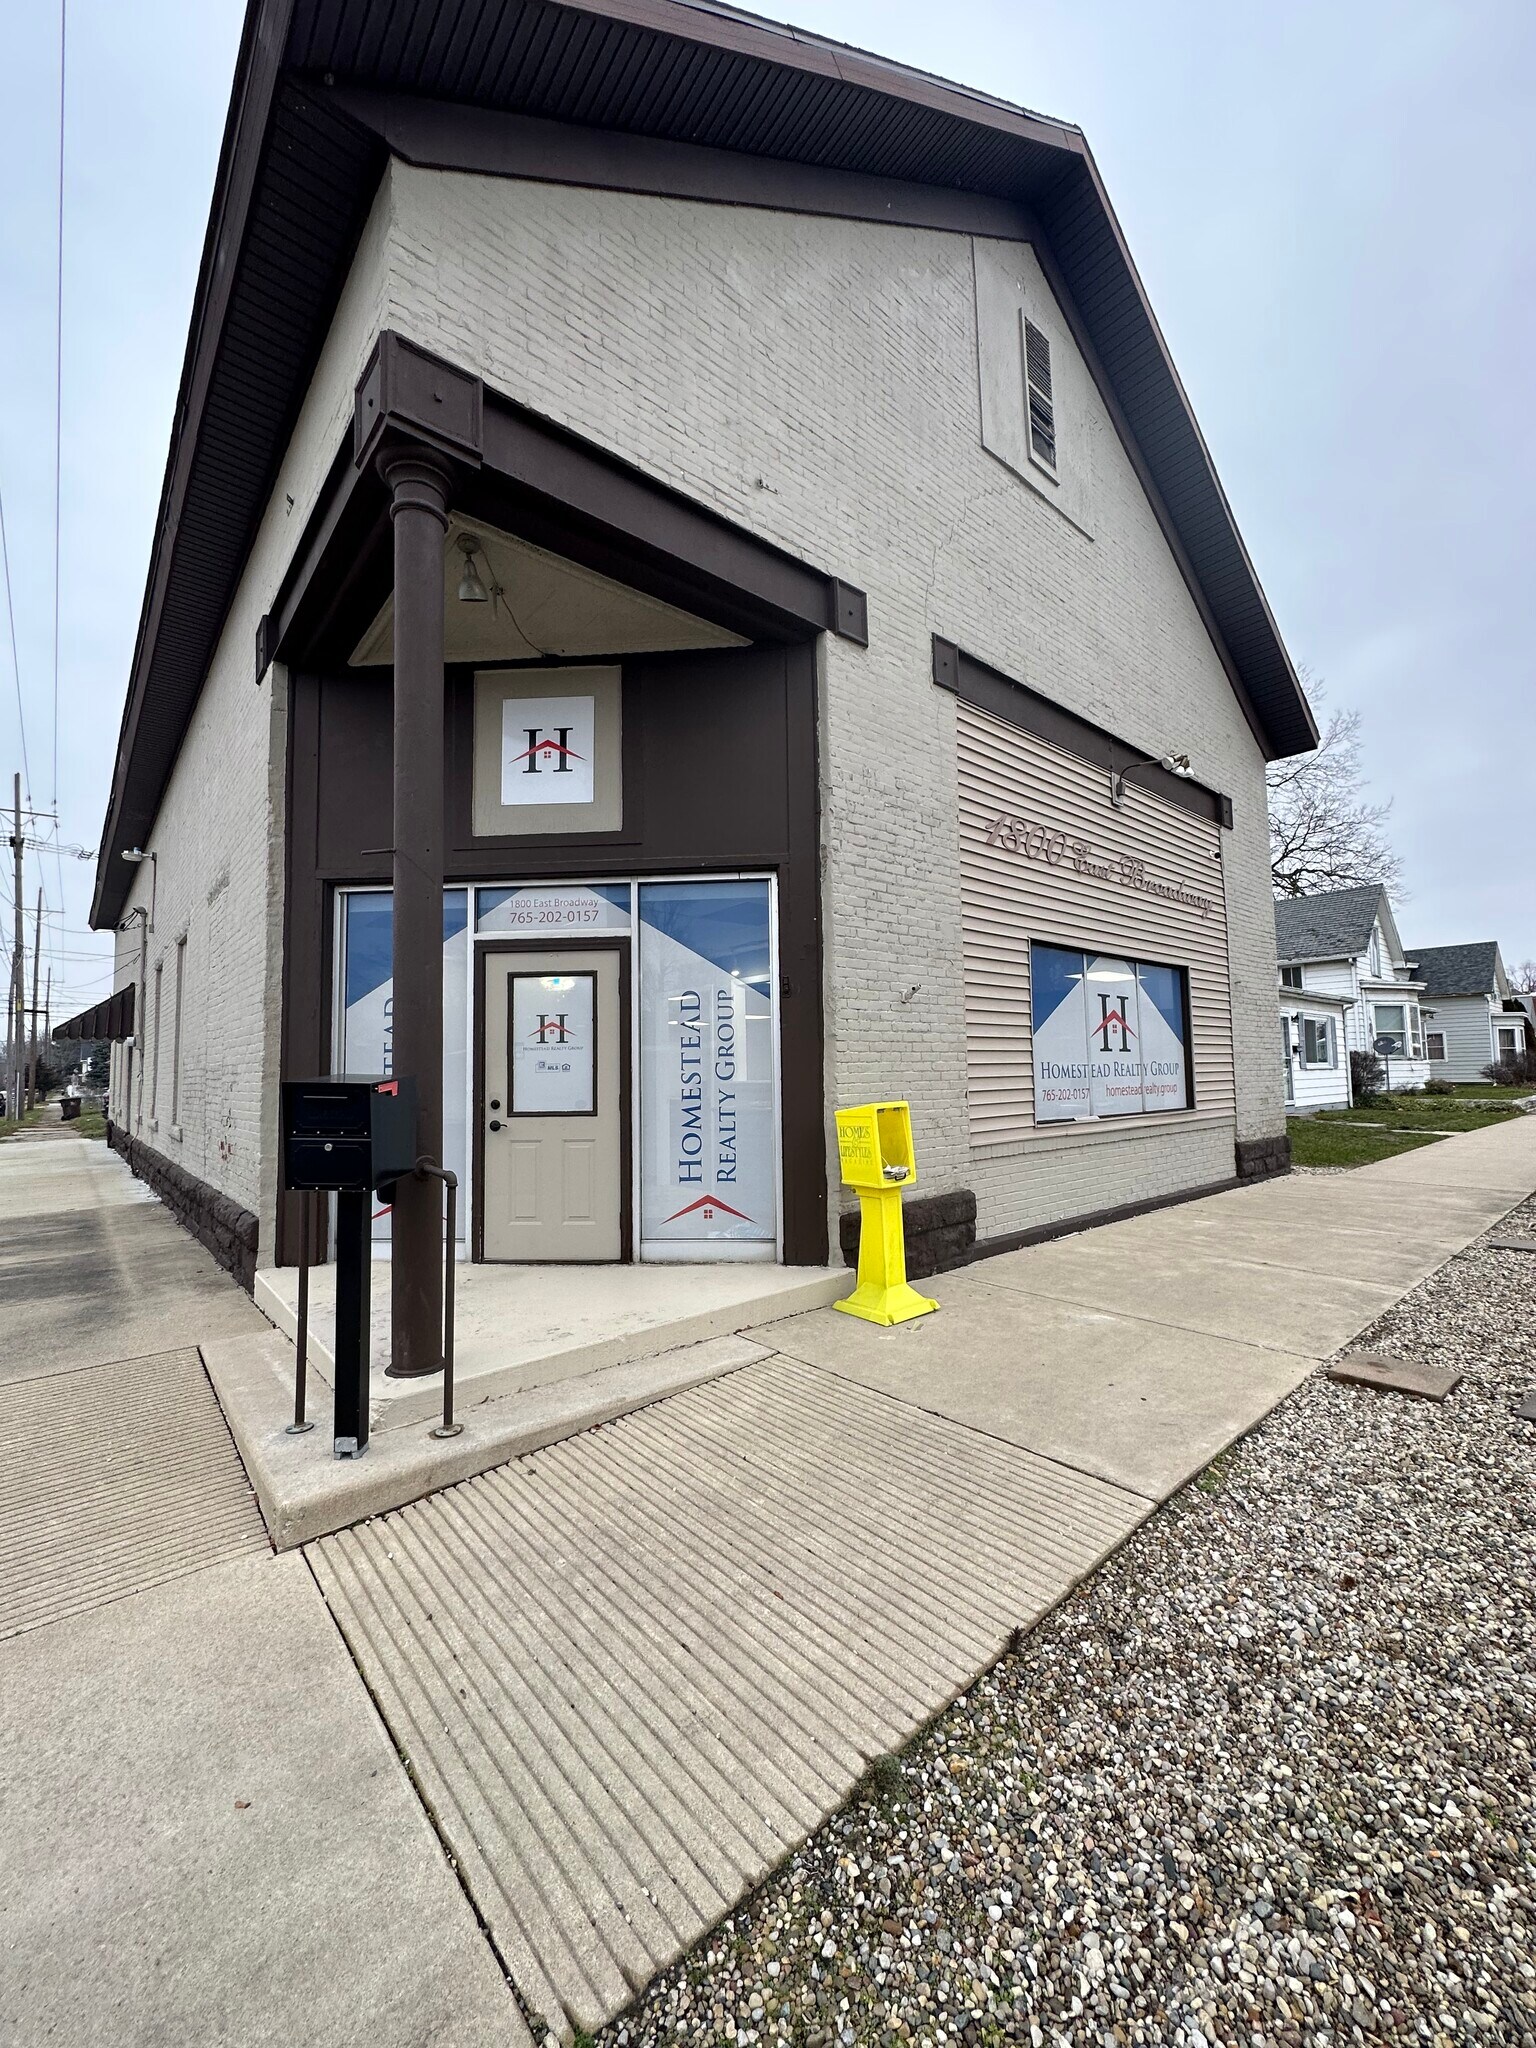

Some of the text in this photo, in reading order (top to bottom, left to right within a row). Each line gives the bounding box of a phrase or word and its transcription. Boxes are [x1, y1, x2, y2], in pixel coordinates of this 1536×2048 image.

[985, 813, 1213, 919] 1800 East Broadway
[510, 897, 599, 909] 1800 East Broadway
[510, 910, 599, 924] 765-202-0157
[1040, 1060, 1180, 1080] HOMESTEAD REALTY GROUP
[678, 990, 703, 1184] HOMESTEAD
[714, 989, 737, 1183] REALTY GROUP
[1042, 1088, 1090, 1101] 765-202-0157
[839, 1125, 871, 1139] HOMES
